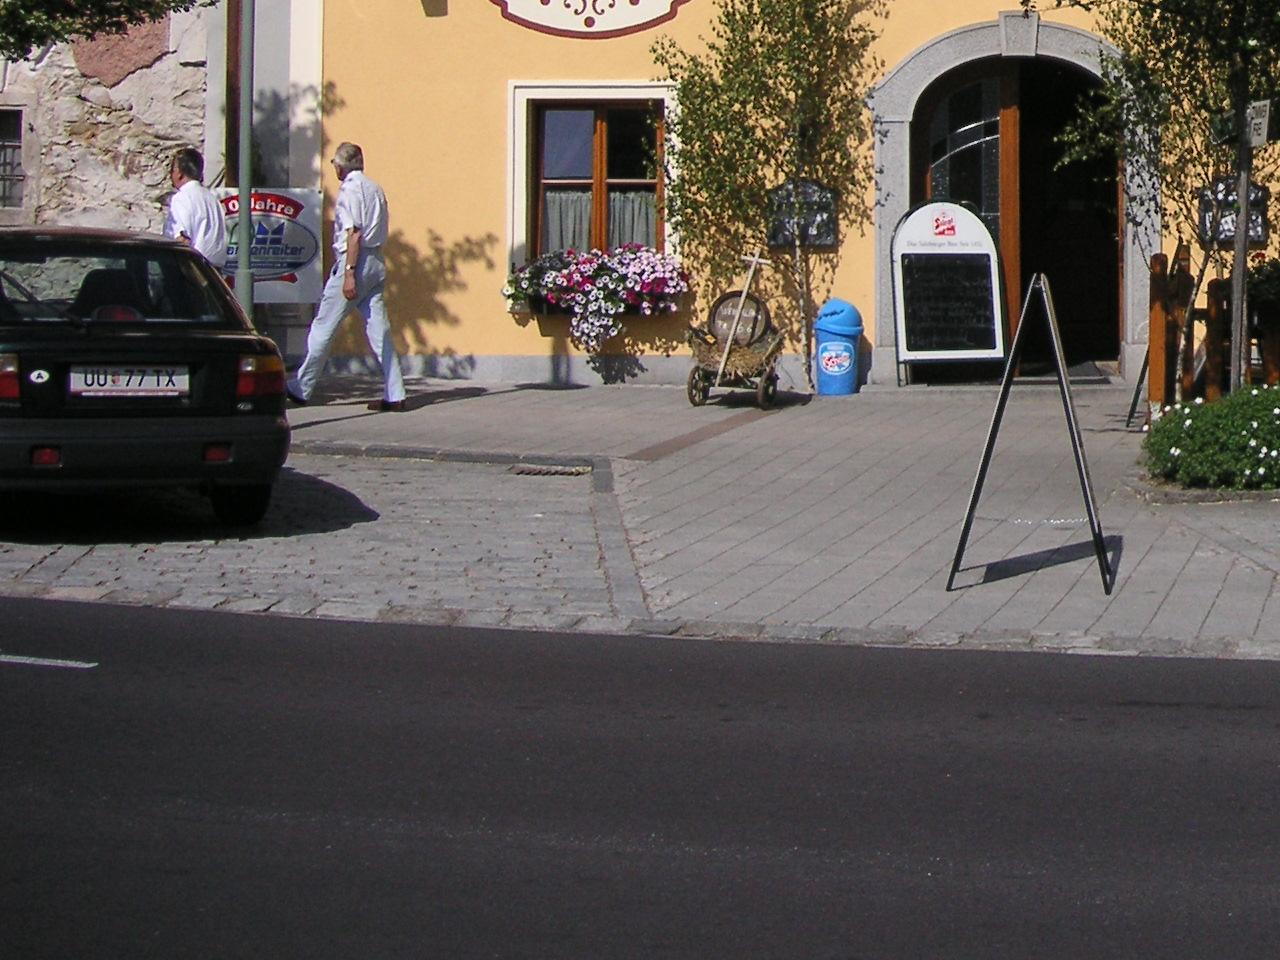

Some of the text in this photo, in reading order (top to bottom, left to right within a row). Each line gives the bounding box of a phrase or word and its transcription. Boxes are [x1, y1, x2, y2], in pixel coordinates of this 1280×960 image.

[83, 369, 176, 387] UU 77 TX
